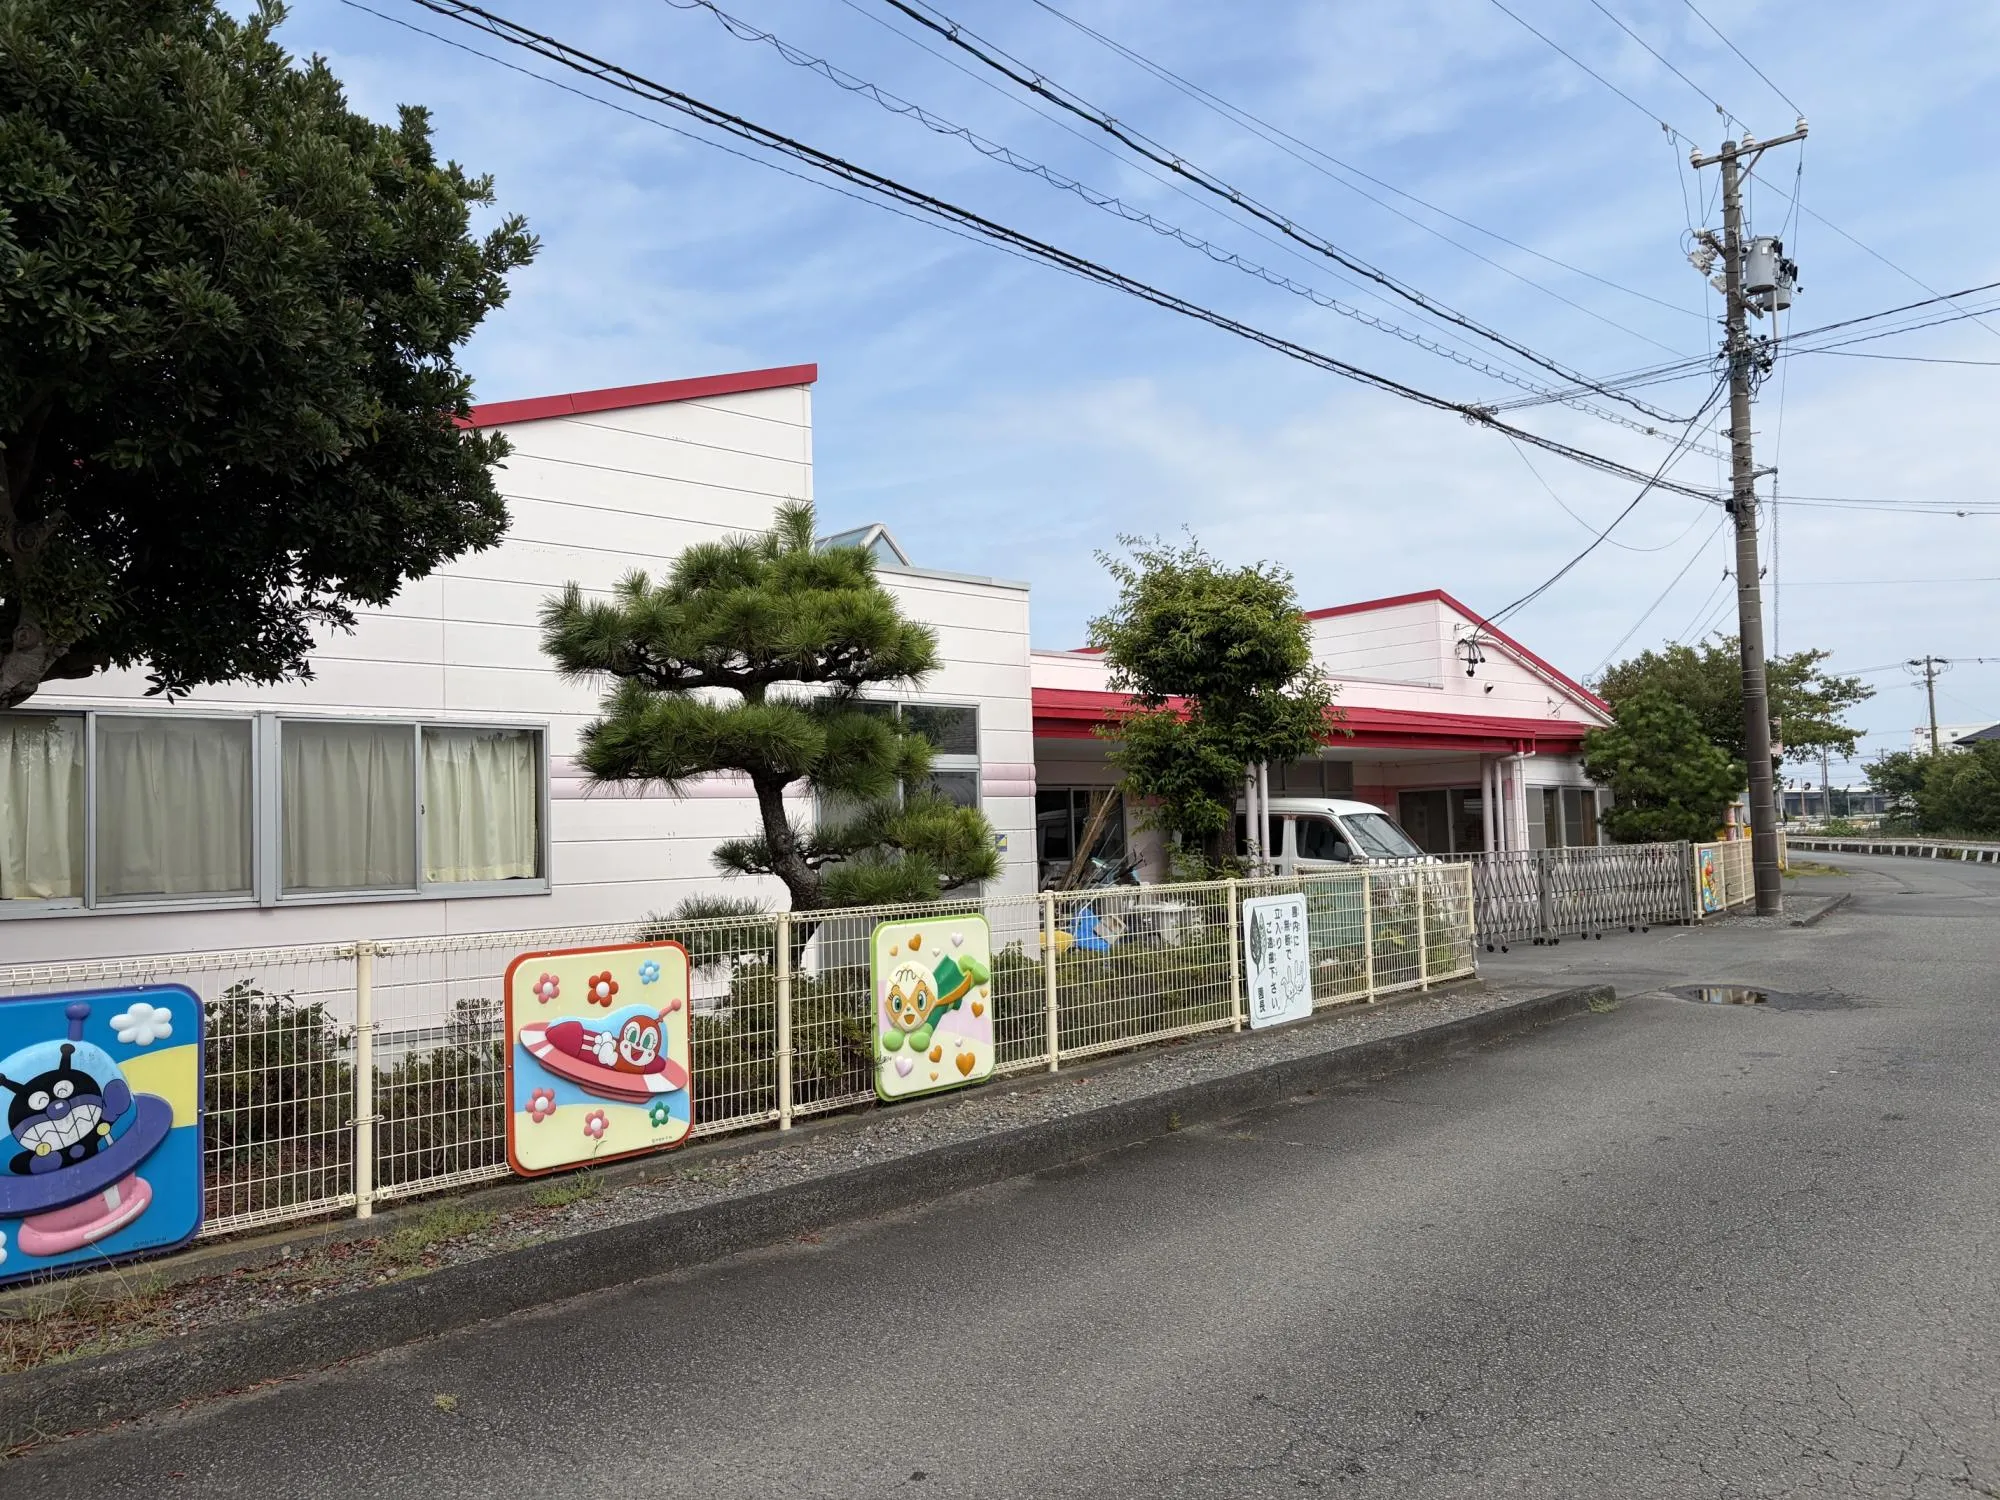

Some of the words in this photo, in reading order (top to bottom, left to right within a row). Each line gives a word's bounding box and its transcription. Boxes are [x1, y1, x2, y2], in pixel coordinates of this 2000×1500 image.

[1274, 908, 1282, 950] 立入り
[1284, 919, 1292, 961] 無断で
[1292, 905, 1300, 948] 園内に
[1257, 987, 1266, 1013] 園長
